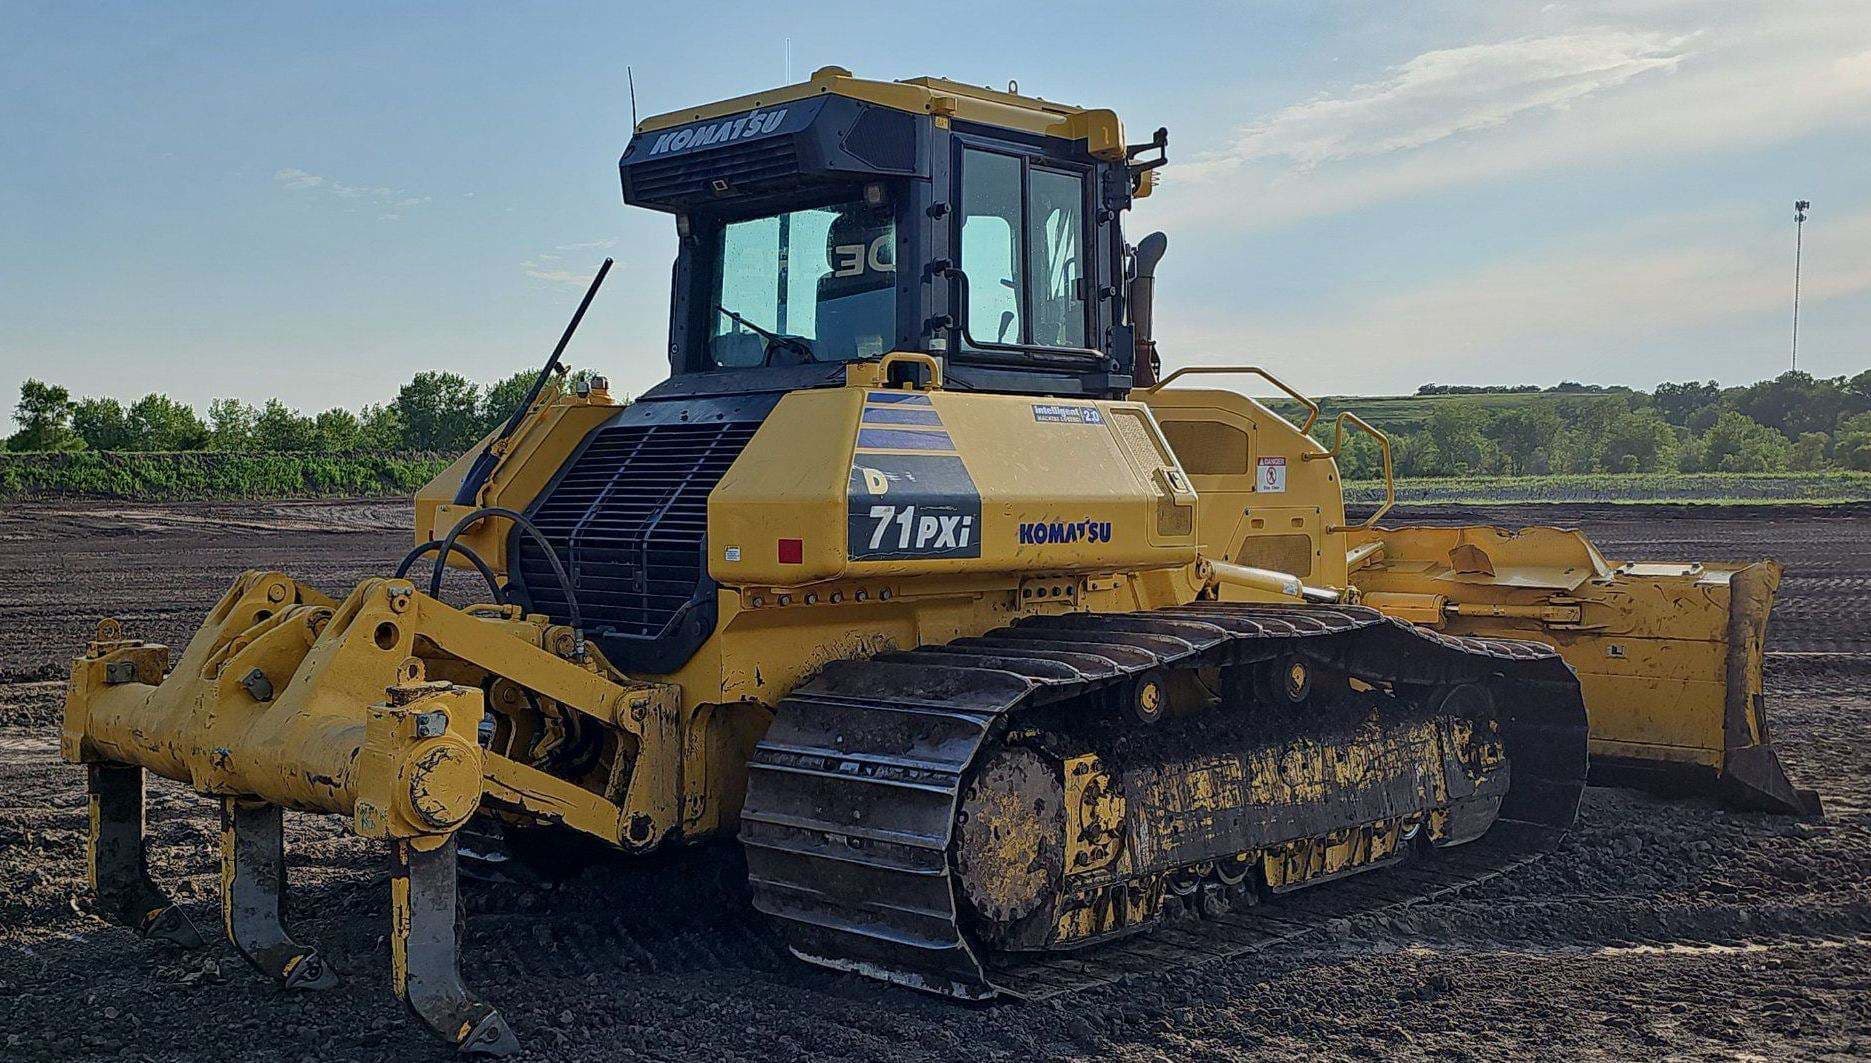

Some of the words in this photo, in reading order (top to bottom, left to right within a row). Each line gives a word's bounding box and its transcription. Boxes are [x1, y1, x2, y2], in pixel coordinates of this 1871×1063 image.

[649, 109, 788, 155] KOMATSU
[1034, 405, 1079, 417] Intelligent
[1083, 409, 1100, 422] 2.0
[863, 468, 889, 495] D
[1019, 519, 1112, 544] KOMATSU
